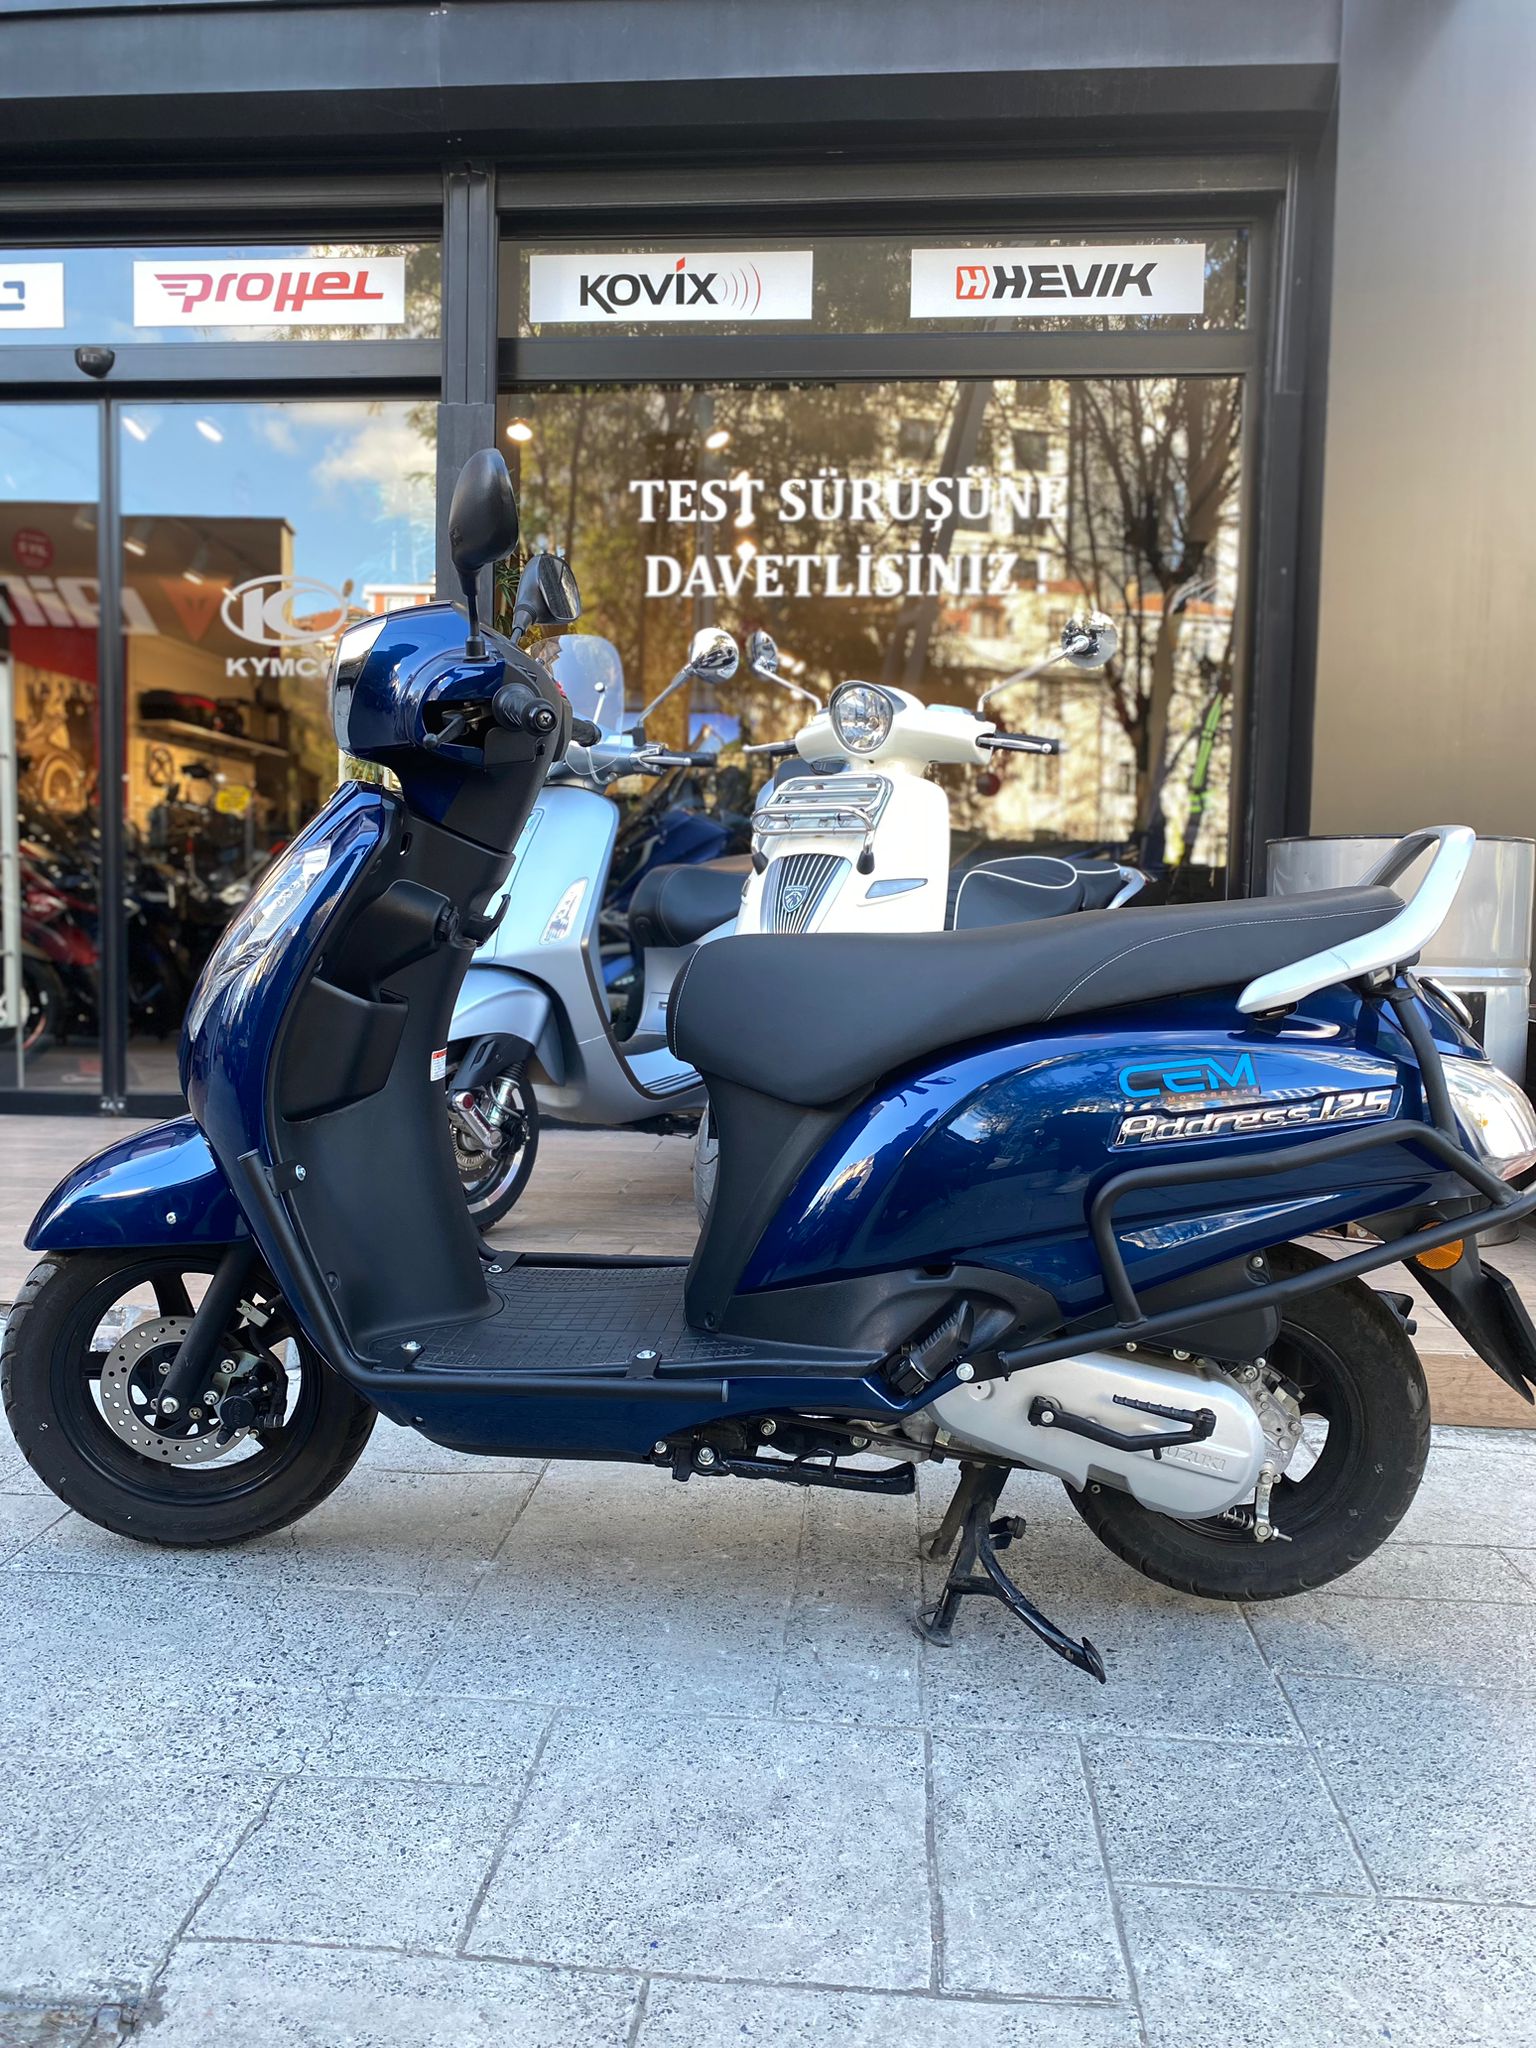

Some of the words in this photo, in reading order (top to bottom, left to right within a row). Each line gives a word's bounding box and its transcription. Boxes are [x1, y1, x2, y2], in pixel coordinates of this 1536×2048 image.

[992, 263, 1158, 299] HEVIK
[629, 479, 765, 523] TEST
[778, 466, 1069, 532] SÜRÜŞÜNE
[1118, 1053, 1258, 1098] CEM
[1166, 1086, 1260, 1105] MOTORBIKE
[1115, 1106, 1312, 1146] Address
[1308, 1088, 1393, 1123] 125
[1162, 1446, 1227, 1473] UZUKI
